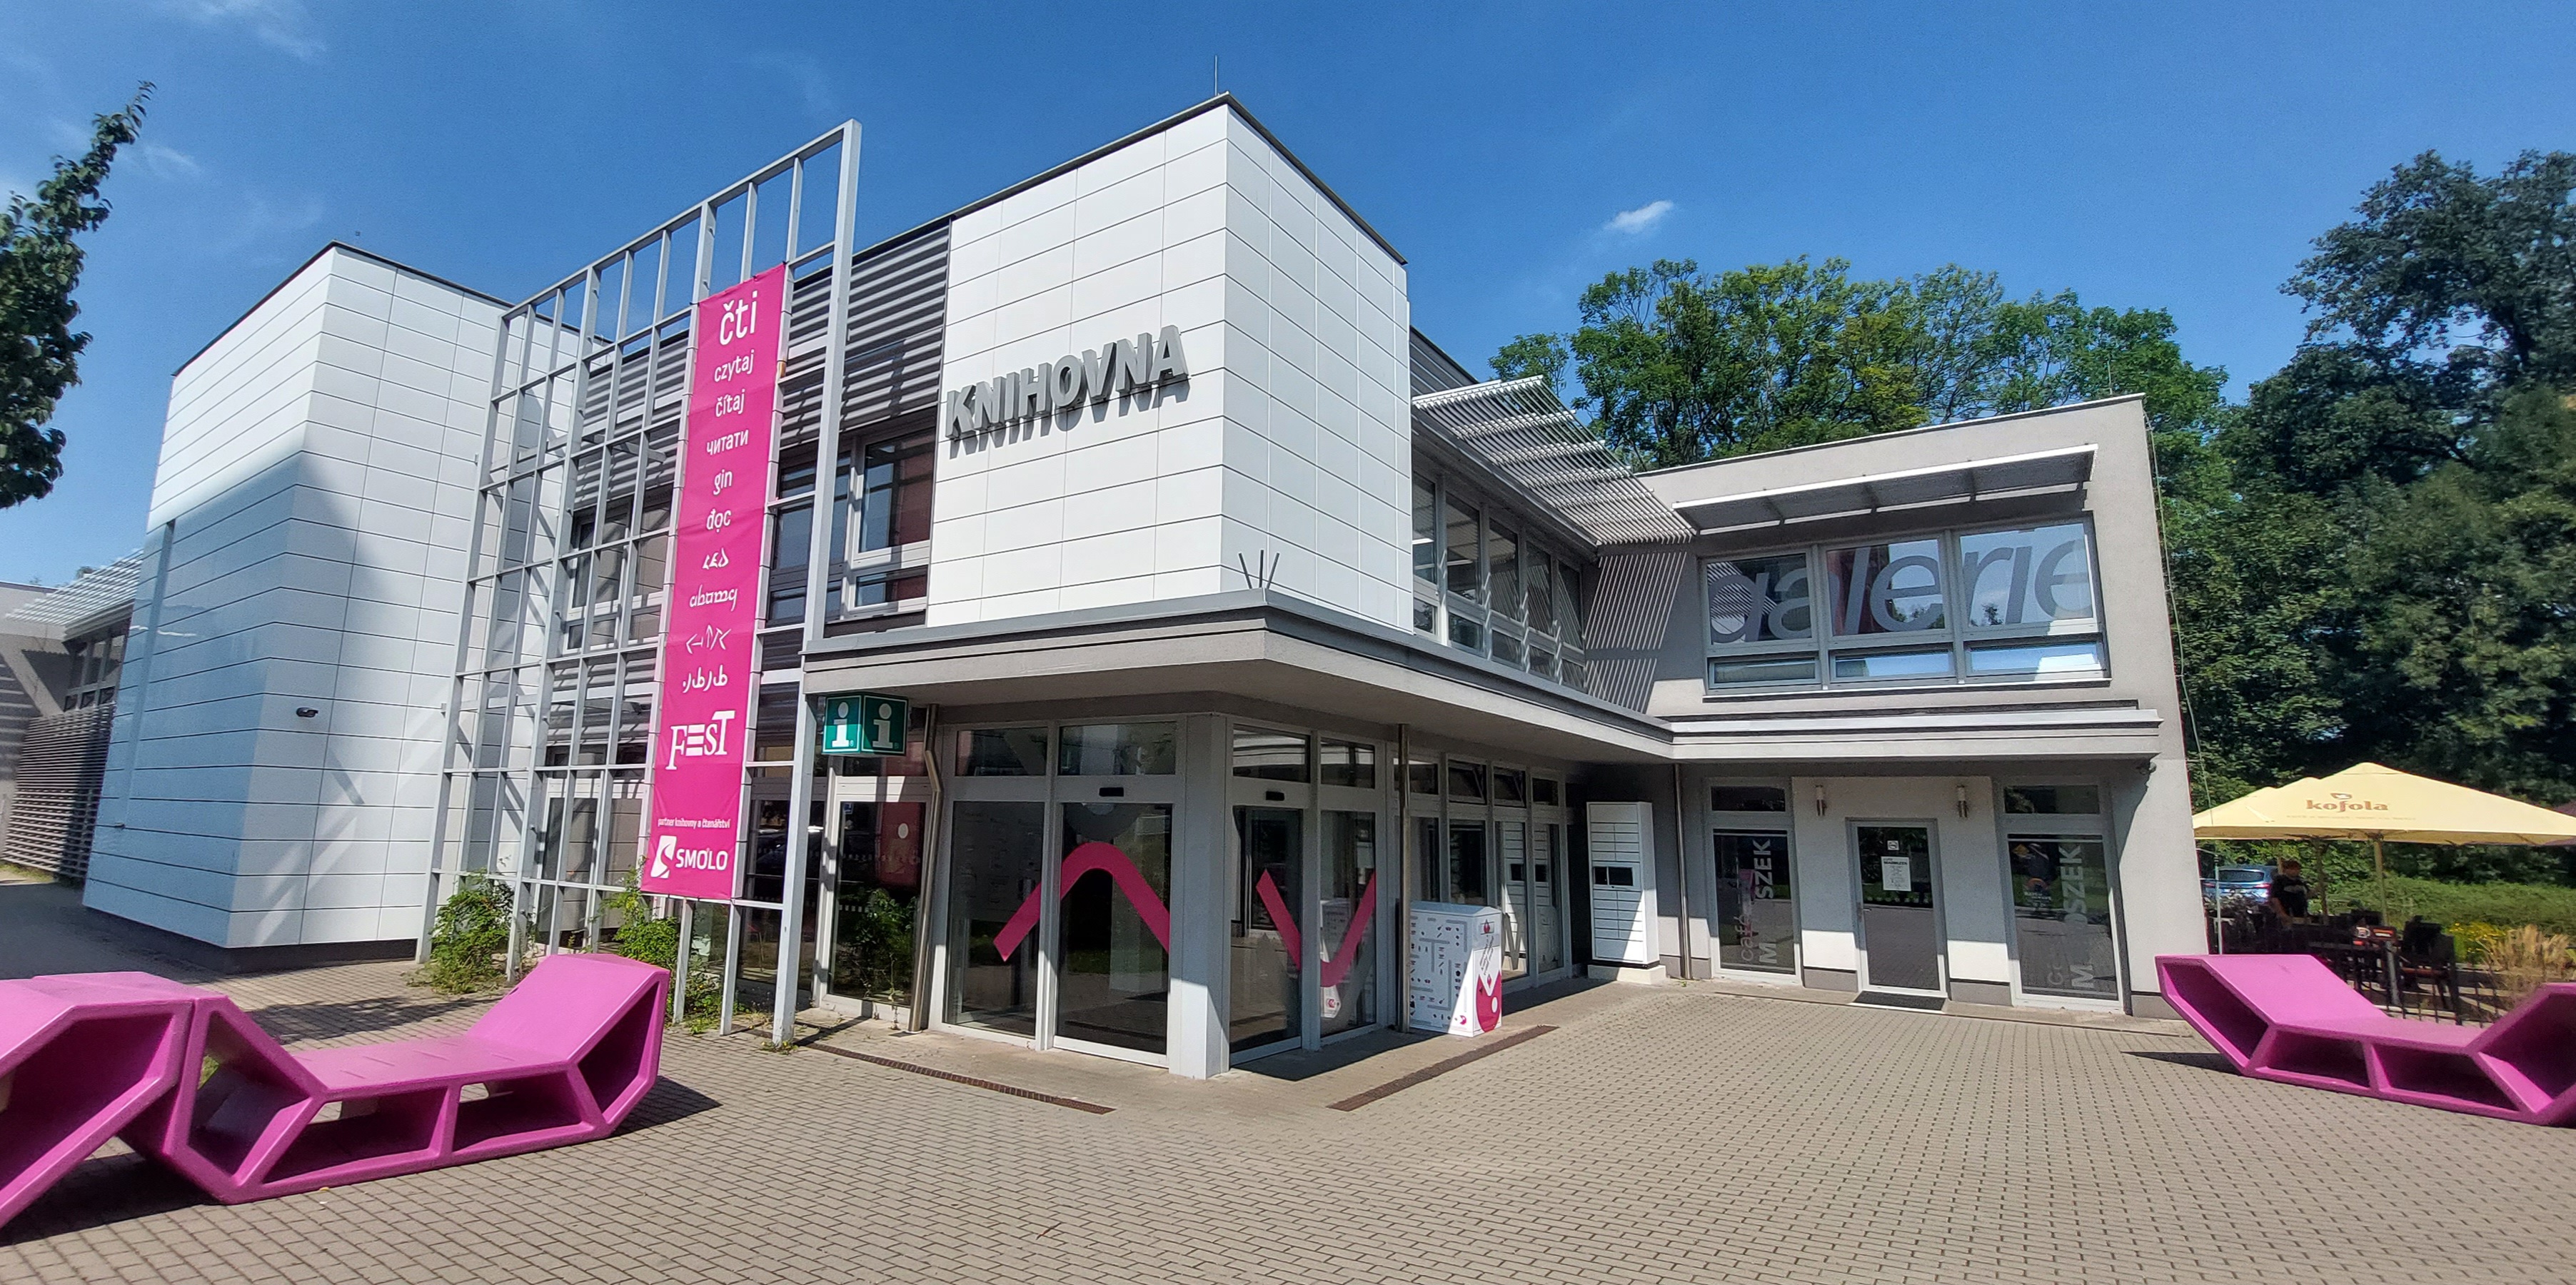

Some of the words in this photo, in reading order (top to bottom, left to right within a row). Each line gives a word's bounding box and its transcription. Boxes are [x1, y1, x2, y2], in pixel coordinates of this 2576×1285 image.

[719, 290, 758, 346] čti
[714, 349, 755, 383] czytaj
[945, 324, 1189, 439] KNIHOVNA
[715, 389, 745, 418] čítaj
[706, 430, 749, 456] читати
[713, 469, 733, 495] gin
[706, 508, 731, 533] đọc
[1710, 539, 2091, 643] galerie
[665, 710, 735, 770] FEST
[2306, 800, 2389, 812] kofola
[675, 817, 698, 830] knihovny
[675, 847, 728, 871] SMOLO
[1734, 914, 1754, 961] café
